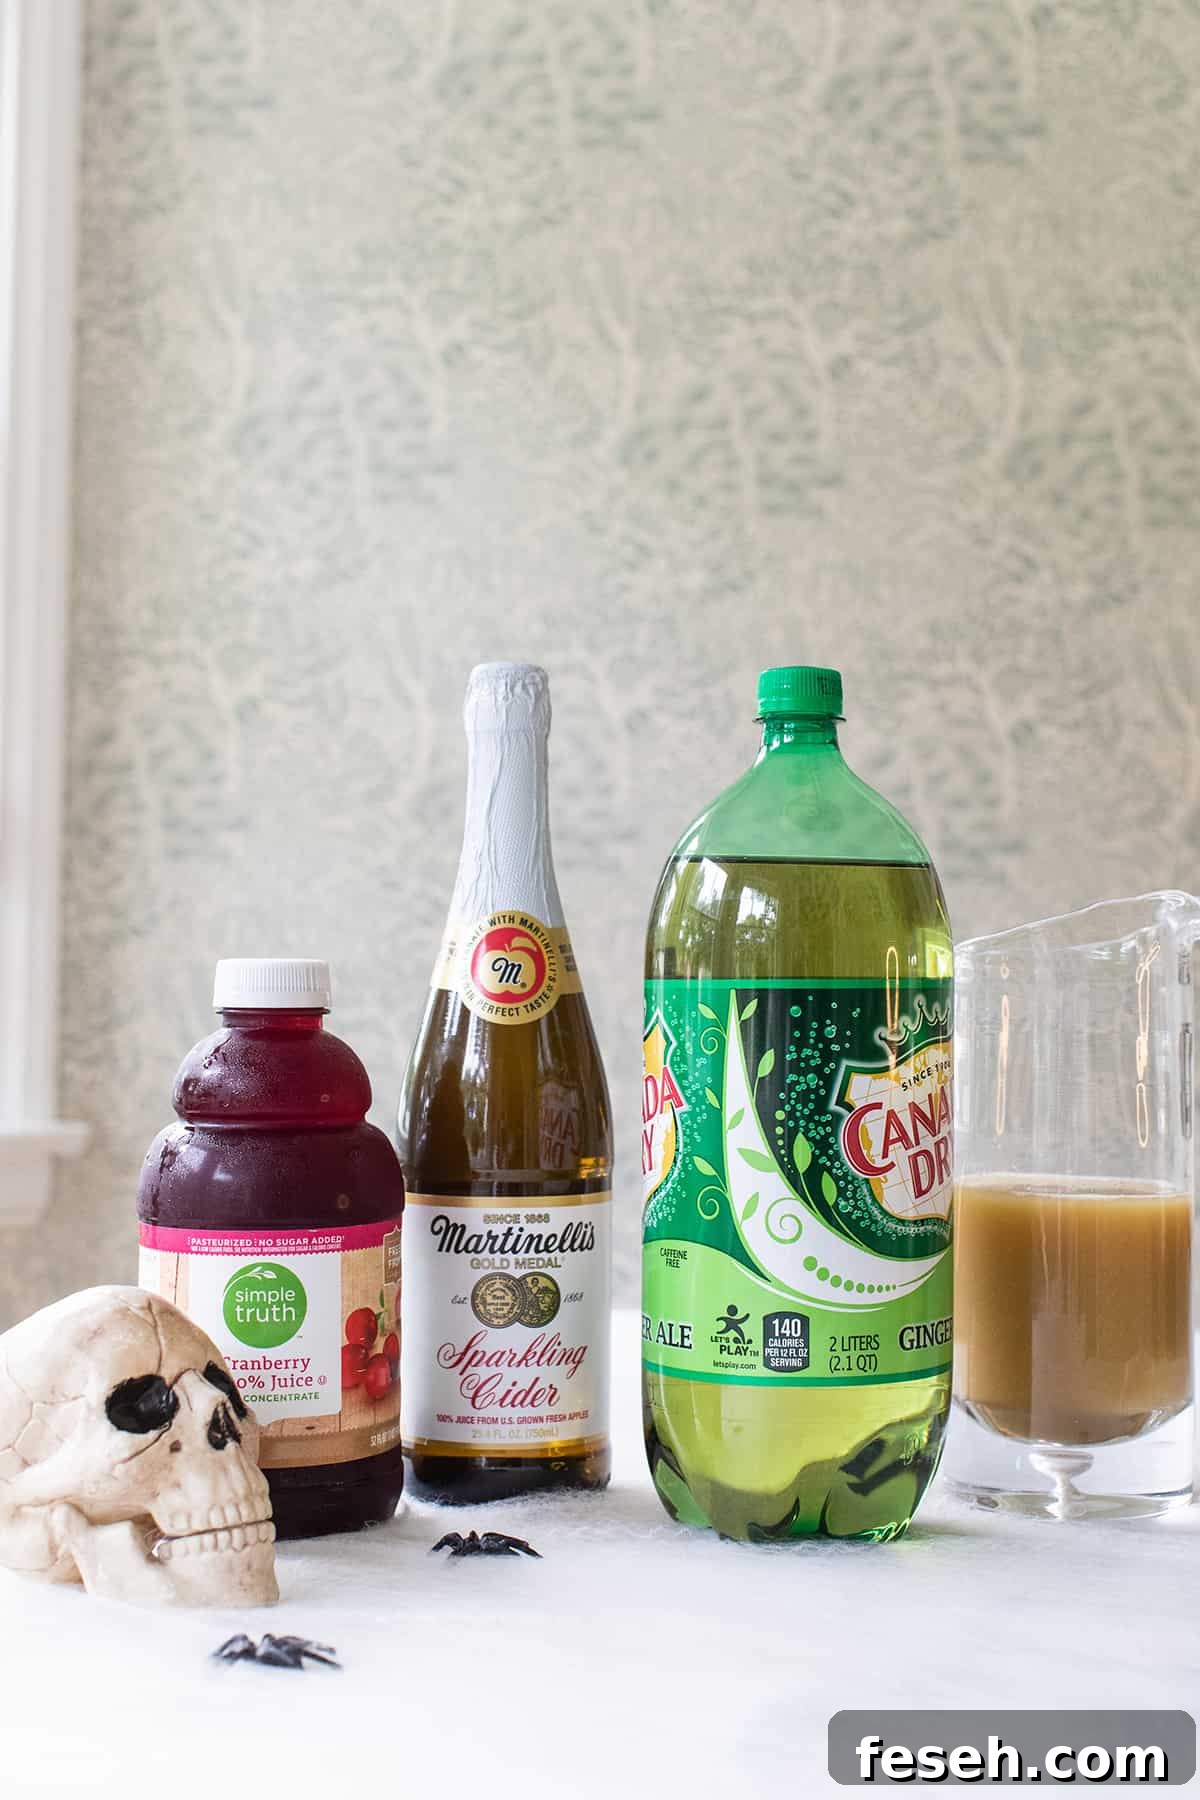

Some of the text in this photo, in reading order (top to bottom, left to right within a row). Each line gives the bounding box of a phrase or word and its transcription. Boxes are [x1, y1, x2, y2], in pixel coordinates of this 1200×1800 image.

[487, 914, 515, 927] WITH
[479, 999, 521, 1017] PERFECT
[523, 991, 550, 1014] TASTE
[901, 1066, 933, 1092] SINCE
[642, 1066, 684, 1124] DA
[483, 1214, 520, 1224] SINCE
[191, 1237, 252, 1247] PASTEURIZED
[258, 1238, 274, 1247] NO
[276, 1237, 309, 1246] SUGAR
[430, 1214, 595, 1254] Martinelli's
[660, 1247, 688, 1260] CAFFEINE
[470, 1258, 510, 1270] GOLD
[665, 1258, 680, 1269] FREE
[235, 1287, 296, 1304] simple
[235, 1304, 296, 1323] truth
[656, 1320, 692, 1350] ALE
[772, 1318, 801, 1337] 140
[710, 1335, 730, 1343] LET'S
[768, 1338, 805, 1348] CALORIES
[829, 1334, 880, 1352] 2 LITERS
[437, 1330, 588, 1380] Sparkling
[765, 1348, 808, 1357] PER 12 FL OZ
[224, 1355, 311, 1373] ranberry
[712, 1359, 757, 1370] letsplay.com
[770, 1357, 803, 1367] SERVING
[829, 1354, 878, 1373] (2.1 QT)
[270, 1374, 313, 1391] Juice
[460, 1372, 560, 1410] Cider
[243, 1392, 320, 1402] CONCENTRATE
[436, 1410, 589, 1425] 100% JUICE FROM U.S. GROWN FRESH APPLES
